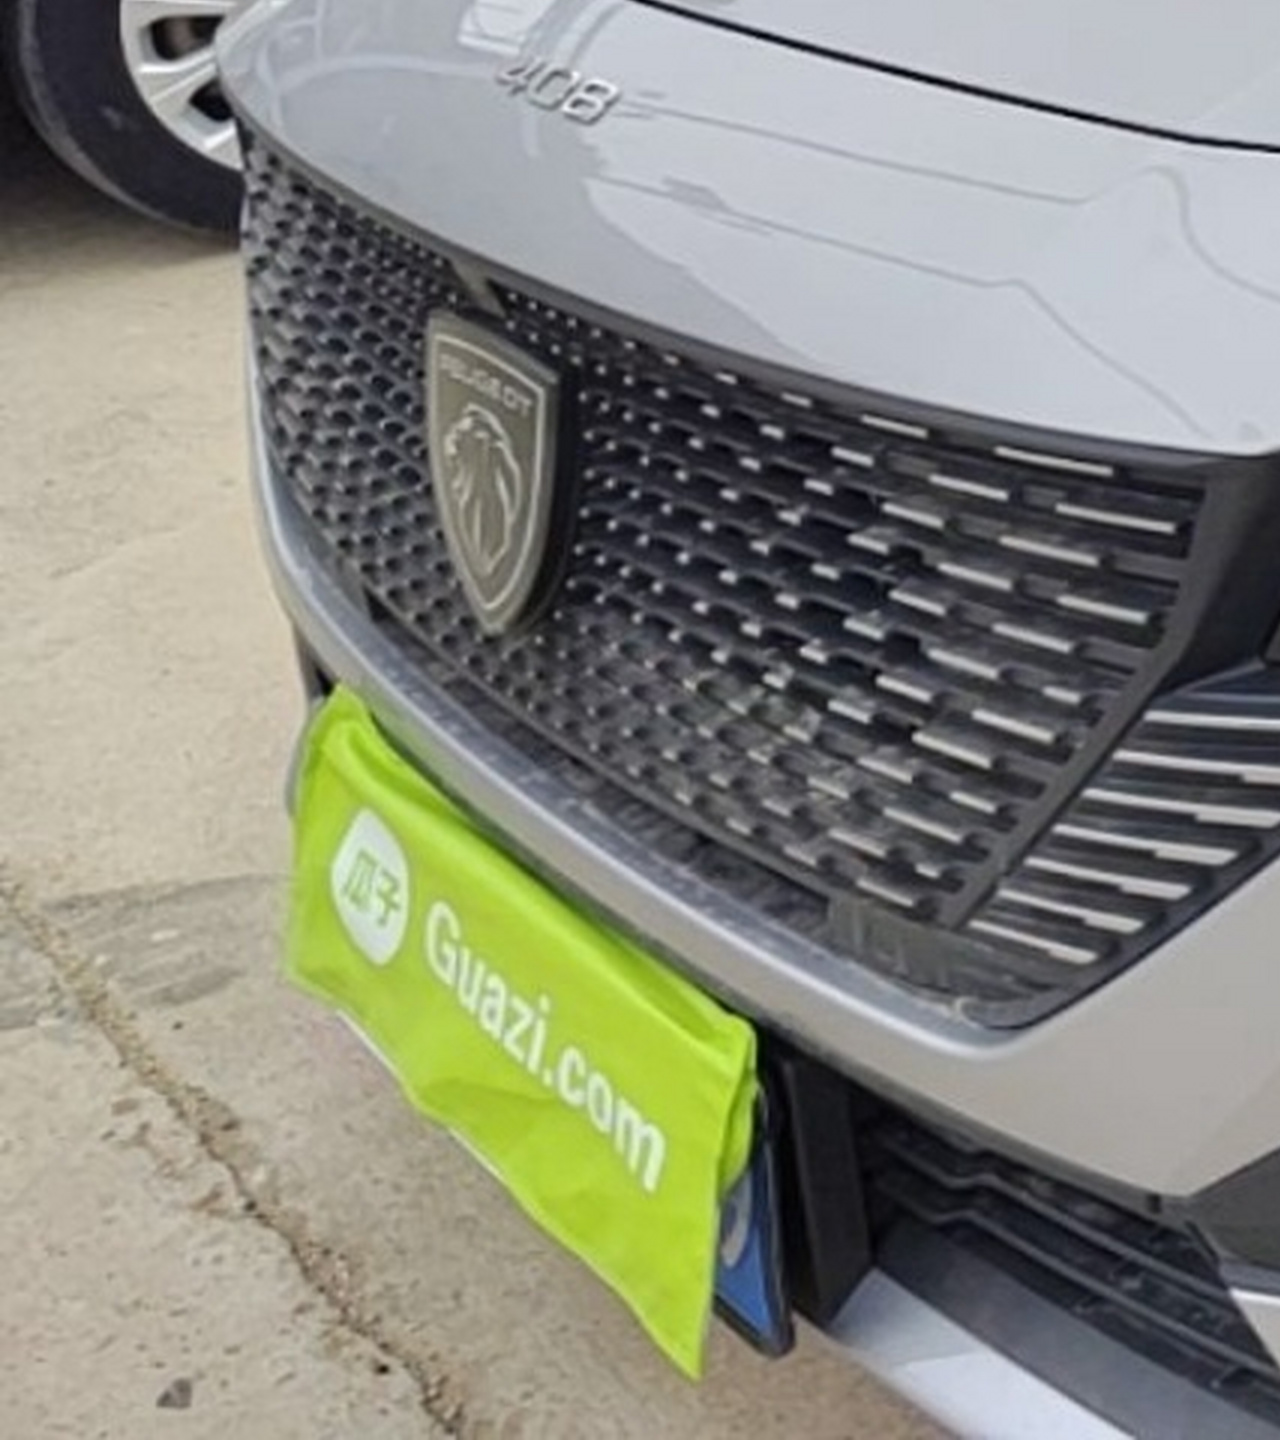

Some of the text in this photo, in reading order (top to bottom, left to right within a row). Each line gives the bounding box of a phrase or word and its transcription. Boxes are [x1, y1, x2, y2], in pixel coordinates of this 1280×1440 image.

[496, 58, 620, 126] 408
[342, 847, 402, 929] 瓜子
[425, 901, 667, 1193] Guazi.com
